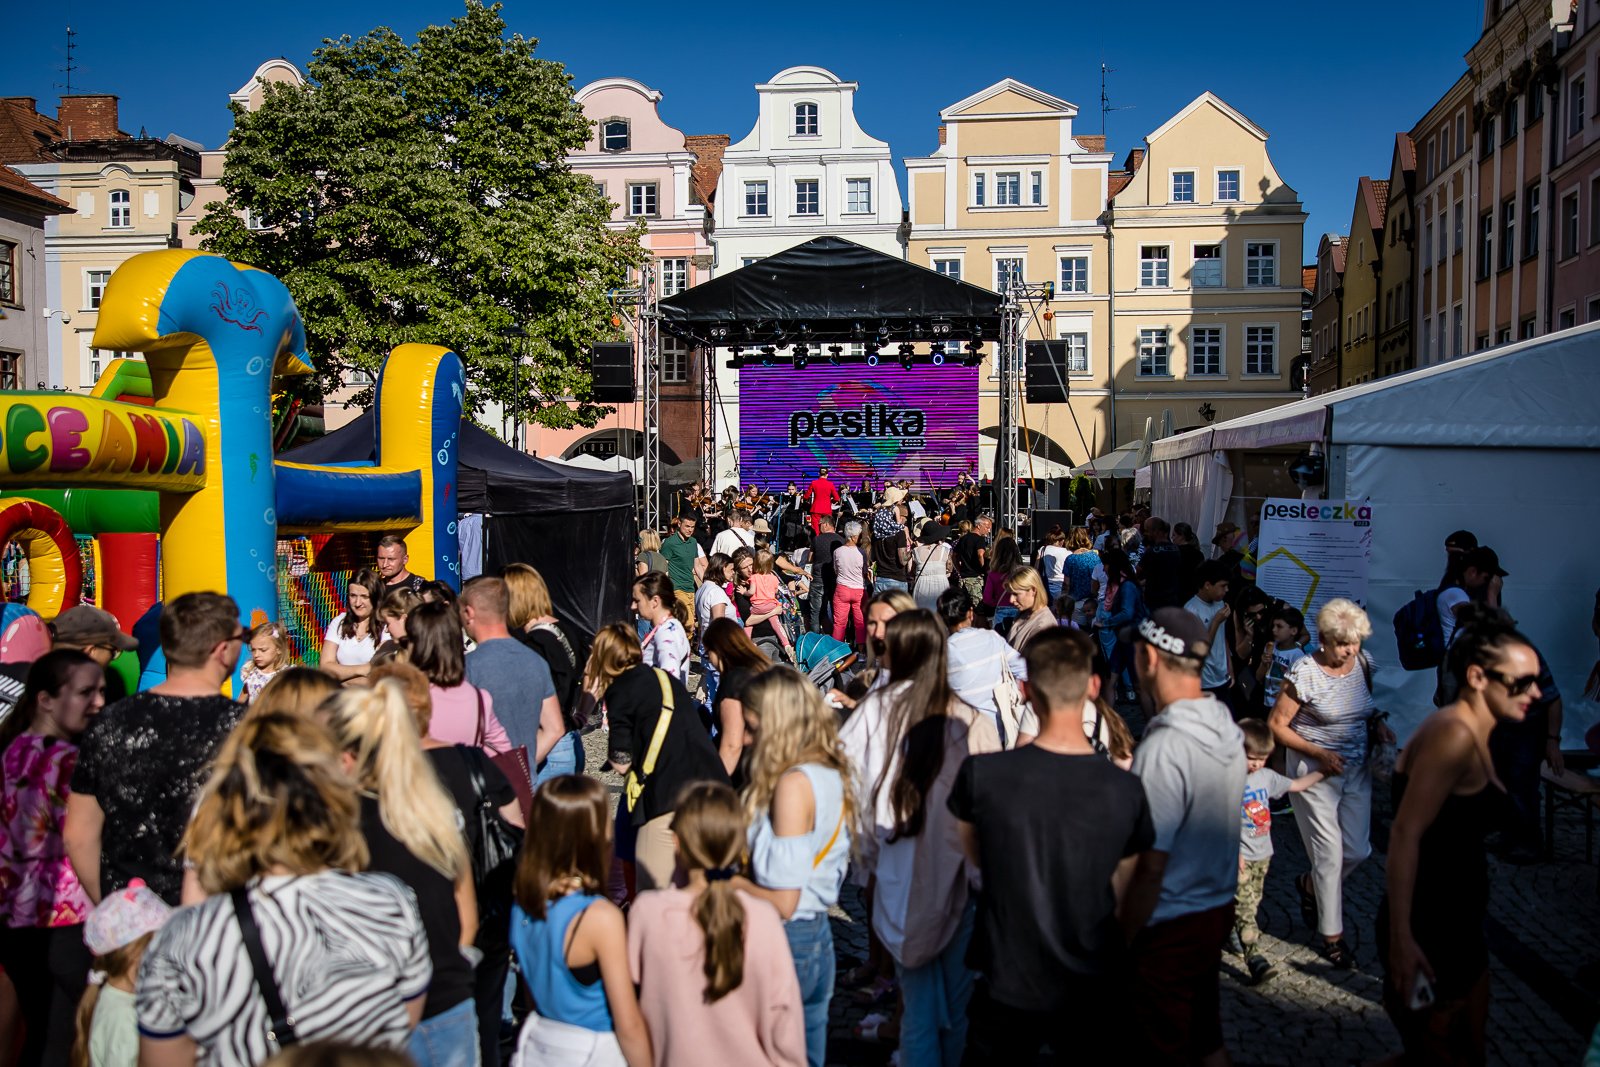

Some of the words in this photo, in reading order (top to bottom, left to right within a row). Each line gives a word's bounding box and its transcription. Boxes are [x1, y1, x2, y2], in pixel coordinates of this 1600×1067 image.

[0, 403, 206, 475] CEANIA
[582, 443, 612, 452] KOBE
[1264, 502, 1371, 520] pesteczka
